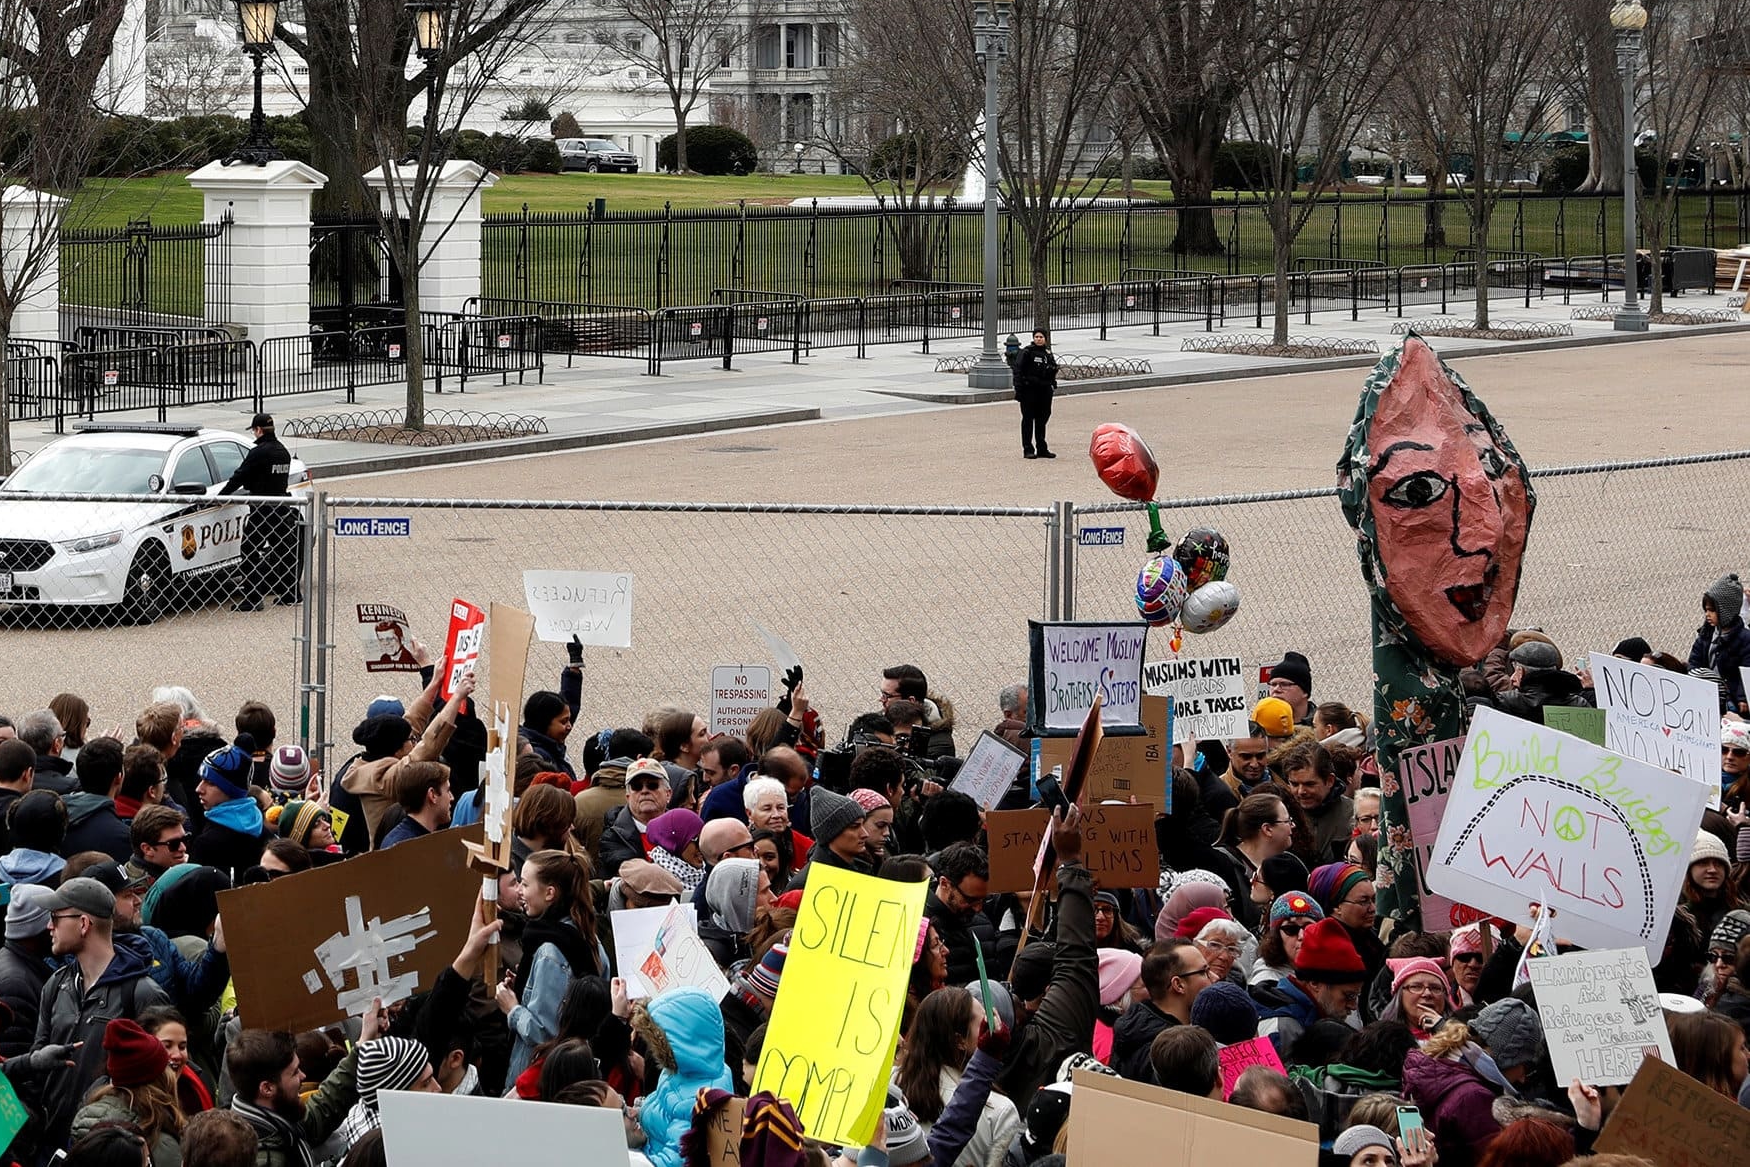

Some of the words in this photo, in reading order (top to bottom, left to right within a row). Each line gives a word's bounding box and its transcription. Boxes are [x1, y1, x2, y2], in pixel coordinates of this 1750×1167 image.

[199, 514, 250, 549] POLIC
[337, 519, 368, 535] LONG
[371, 519, 407, 535] FENCE
[1081, 529, 1100, 544] LONG
[1102, 529, 1122, 544] FENCE
[360, 604, 405, 620] KENNEDY
[1048, 634, 1101, 663] WELCOME
[1106, 631, 1142, 660] MUSLIM
[734, 675, 747, 686] NO
[1144, 660, 1196, 688] MUSLIMS
[1200, 658, 1241, 677] WITH
[714, 689, 767, 700] TRESPASSING
[1050, 672, 1092, 713] BROTHERS
[1100, 667, 1138, 707] SISTERS
[1181, 678, 1227, 697] CARDS
[1603, 666, 1656, 717] NO
[1205, 696, 1245, 714] TAXES
[717, 718, 751, 726] PERSONN
[729, 728, 747, 736] ONL
[1190, 715, 1235, 738] TRUMP
[1616, 712, 1660, 731] AMERICA
[1610, 722, 1649, 764] NO
[1472, 730, 1563, 789] Build
[1108, 828, 1149, 844] WITH
[1085, 849, 1143, 873] LIMS
[1479, 834, 1624, 909] WALLS
[800, 885, 918, 971] SILEN
[1530, 951, 1649, 991] Immigrants
[1578, 985, 1607, 1005] And
[836, 981, 890, 1056] IS
[1541, 1004, 1624, 1034] Refugees
